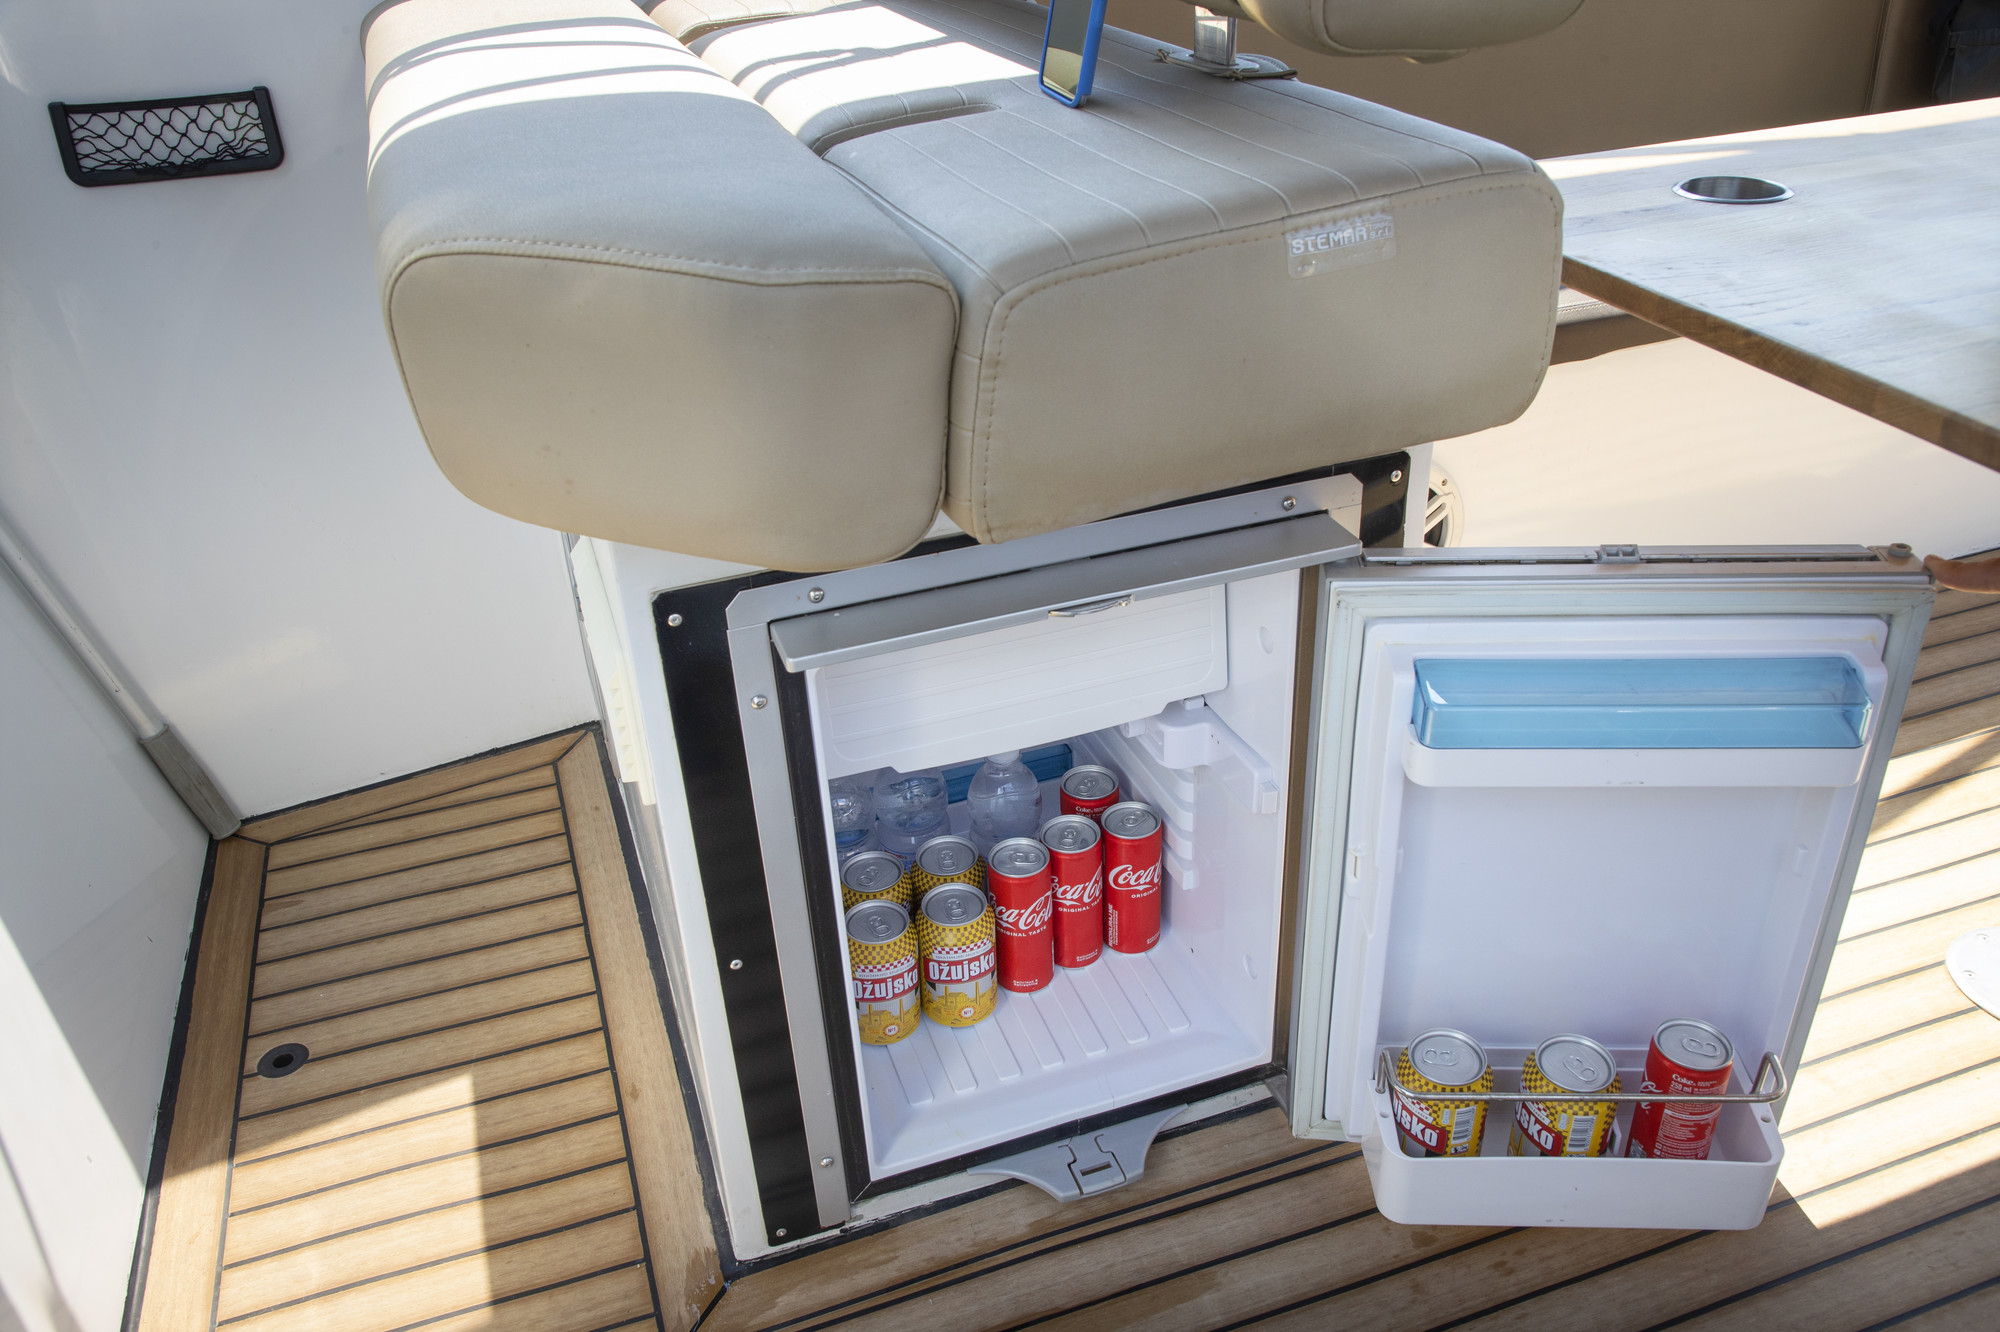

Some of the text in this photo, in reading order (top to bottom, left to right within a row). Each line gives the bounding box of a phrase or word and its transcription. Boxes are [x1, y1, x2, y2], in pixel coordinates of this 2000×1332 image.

[1291, 227, 1367, 254] STEMAR
[1108, 852, 1162, 890] Coca-C
[1131, 886, 1158, 898] ORIGINAL
[996, 924, 1047, 937] ORIGINAL TASTE
[928, 952, 995, 981] Ožujsko
[853, 968, 918, 999] Ožujsko
[1672, 1073, 1694, 1085] Coke
[1393, 1090, 1438, 1147] ujsko
